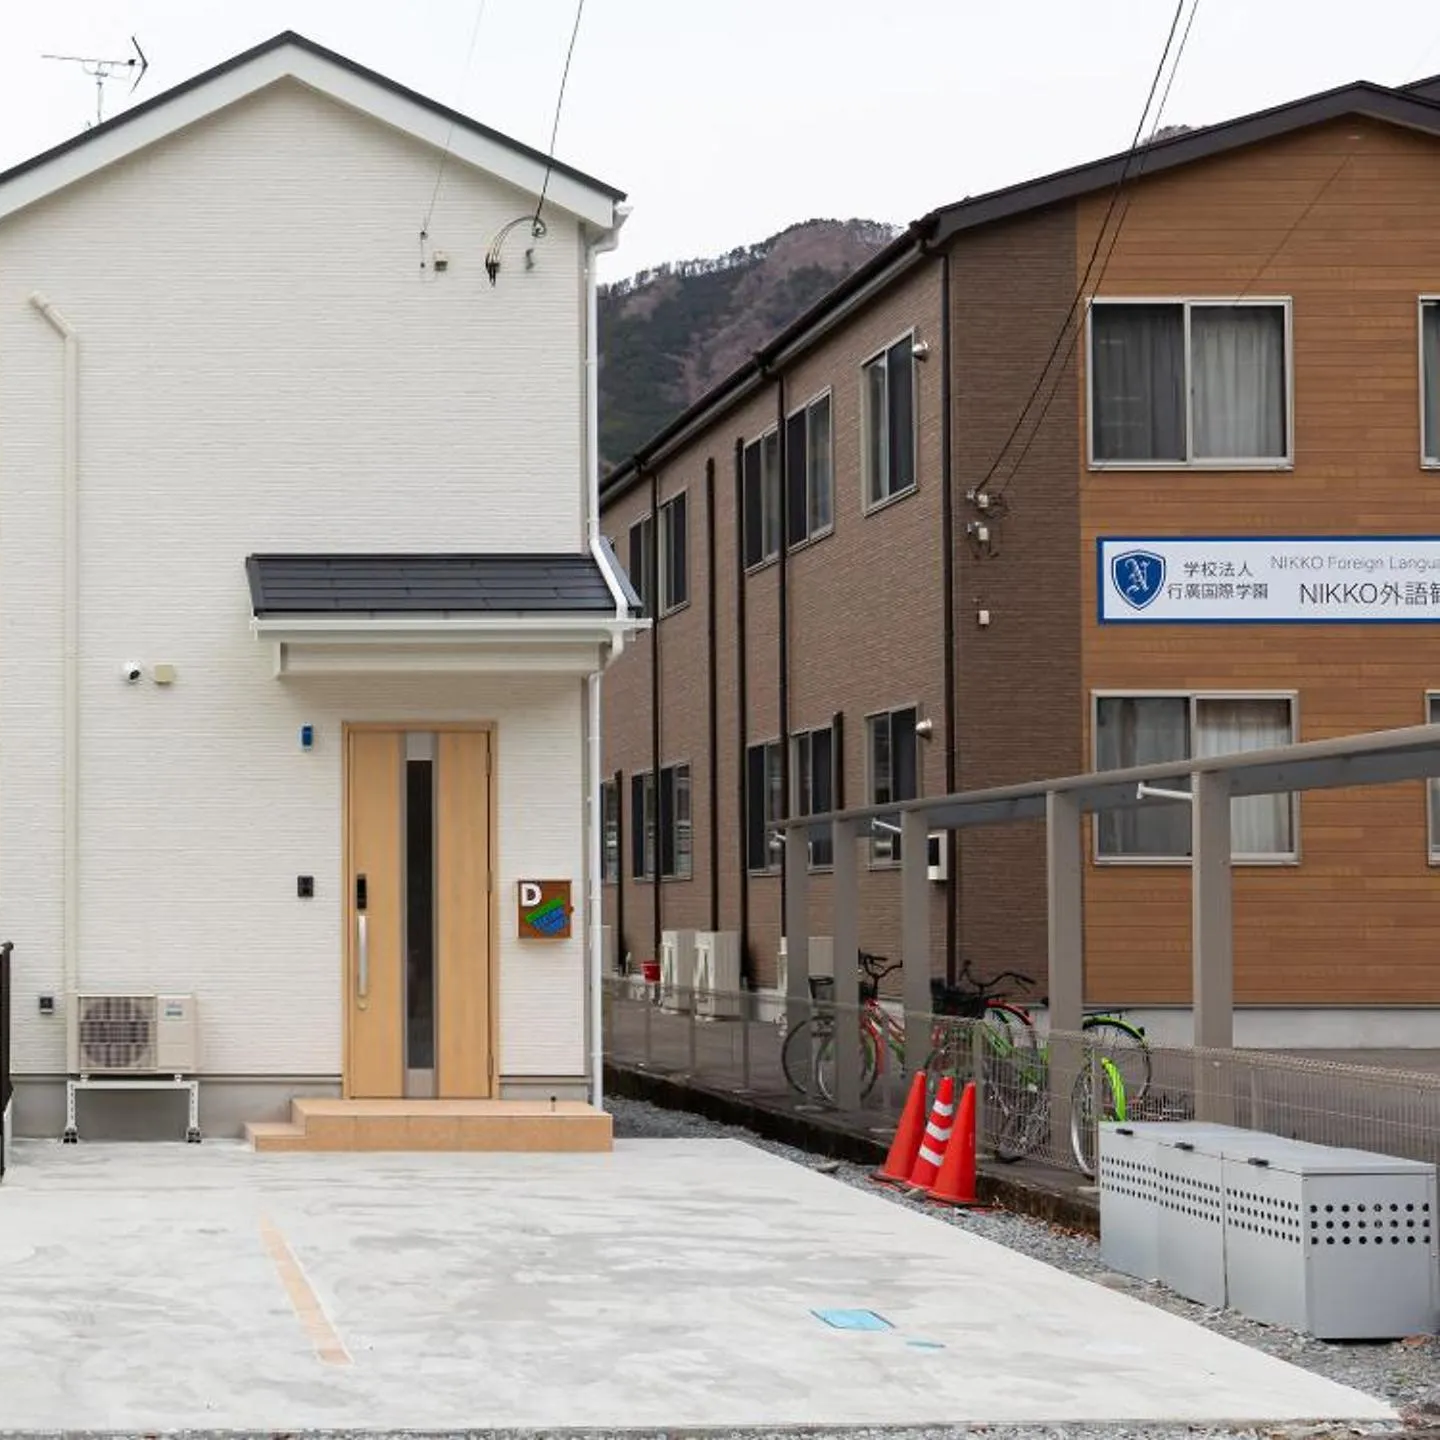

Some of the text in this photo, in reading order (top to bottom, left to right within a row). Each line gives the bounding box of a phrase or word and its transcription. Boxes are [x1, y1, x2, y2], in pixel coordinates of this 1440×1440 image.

[1183, 561, 1254, 577] 学校法人
[1270, 556, 1324, 569] NIKKO
[1328, 556, 1384, 572] Foreign
[521, 883, 542, 907] D
